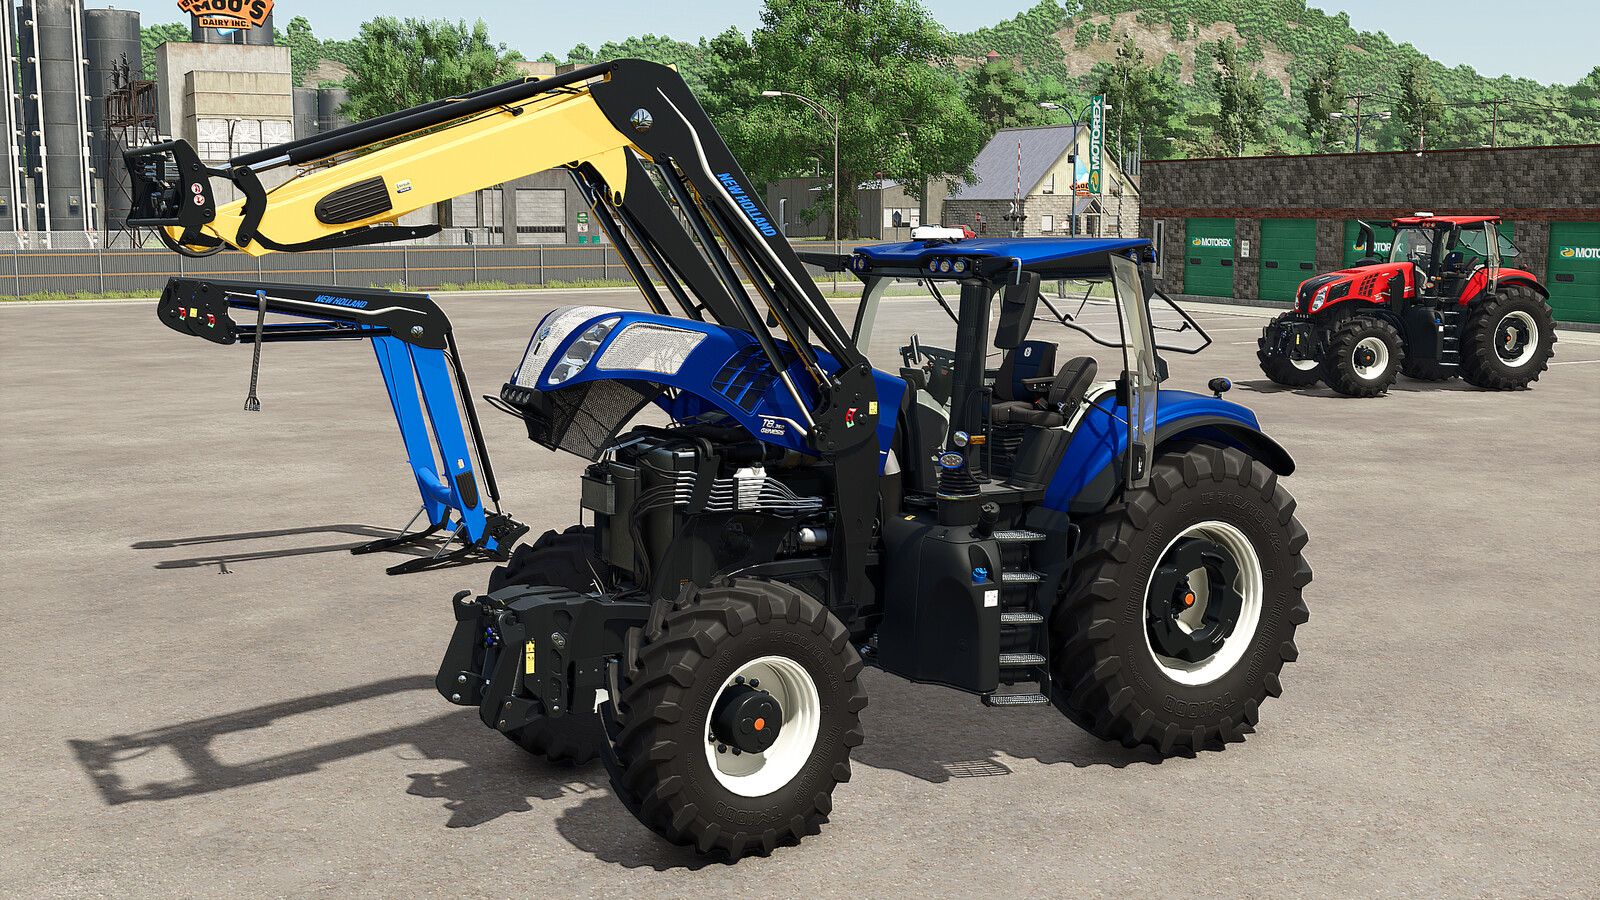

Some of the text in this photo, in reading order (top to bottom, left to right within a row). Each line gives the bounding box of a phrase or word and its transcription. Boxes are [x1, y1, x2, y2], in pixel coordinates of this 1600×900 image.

[1091, 98, 1101, 170] MOTOREX
[717, 172, 777, 236] NEW HOLLAND
[1201, 237, 1232, 247] MOTOREX
[315, 294, 368, 309] NEW HOLLAND
